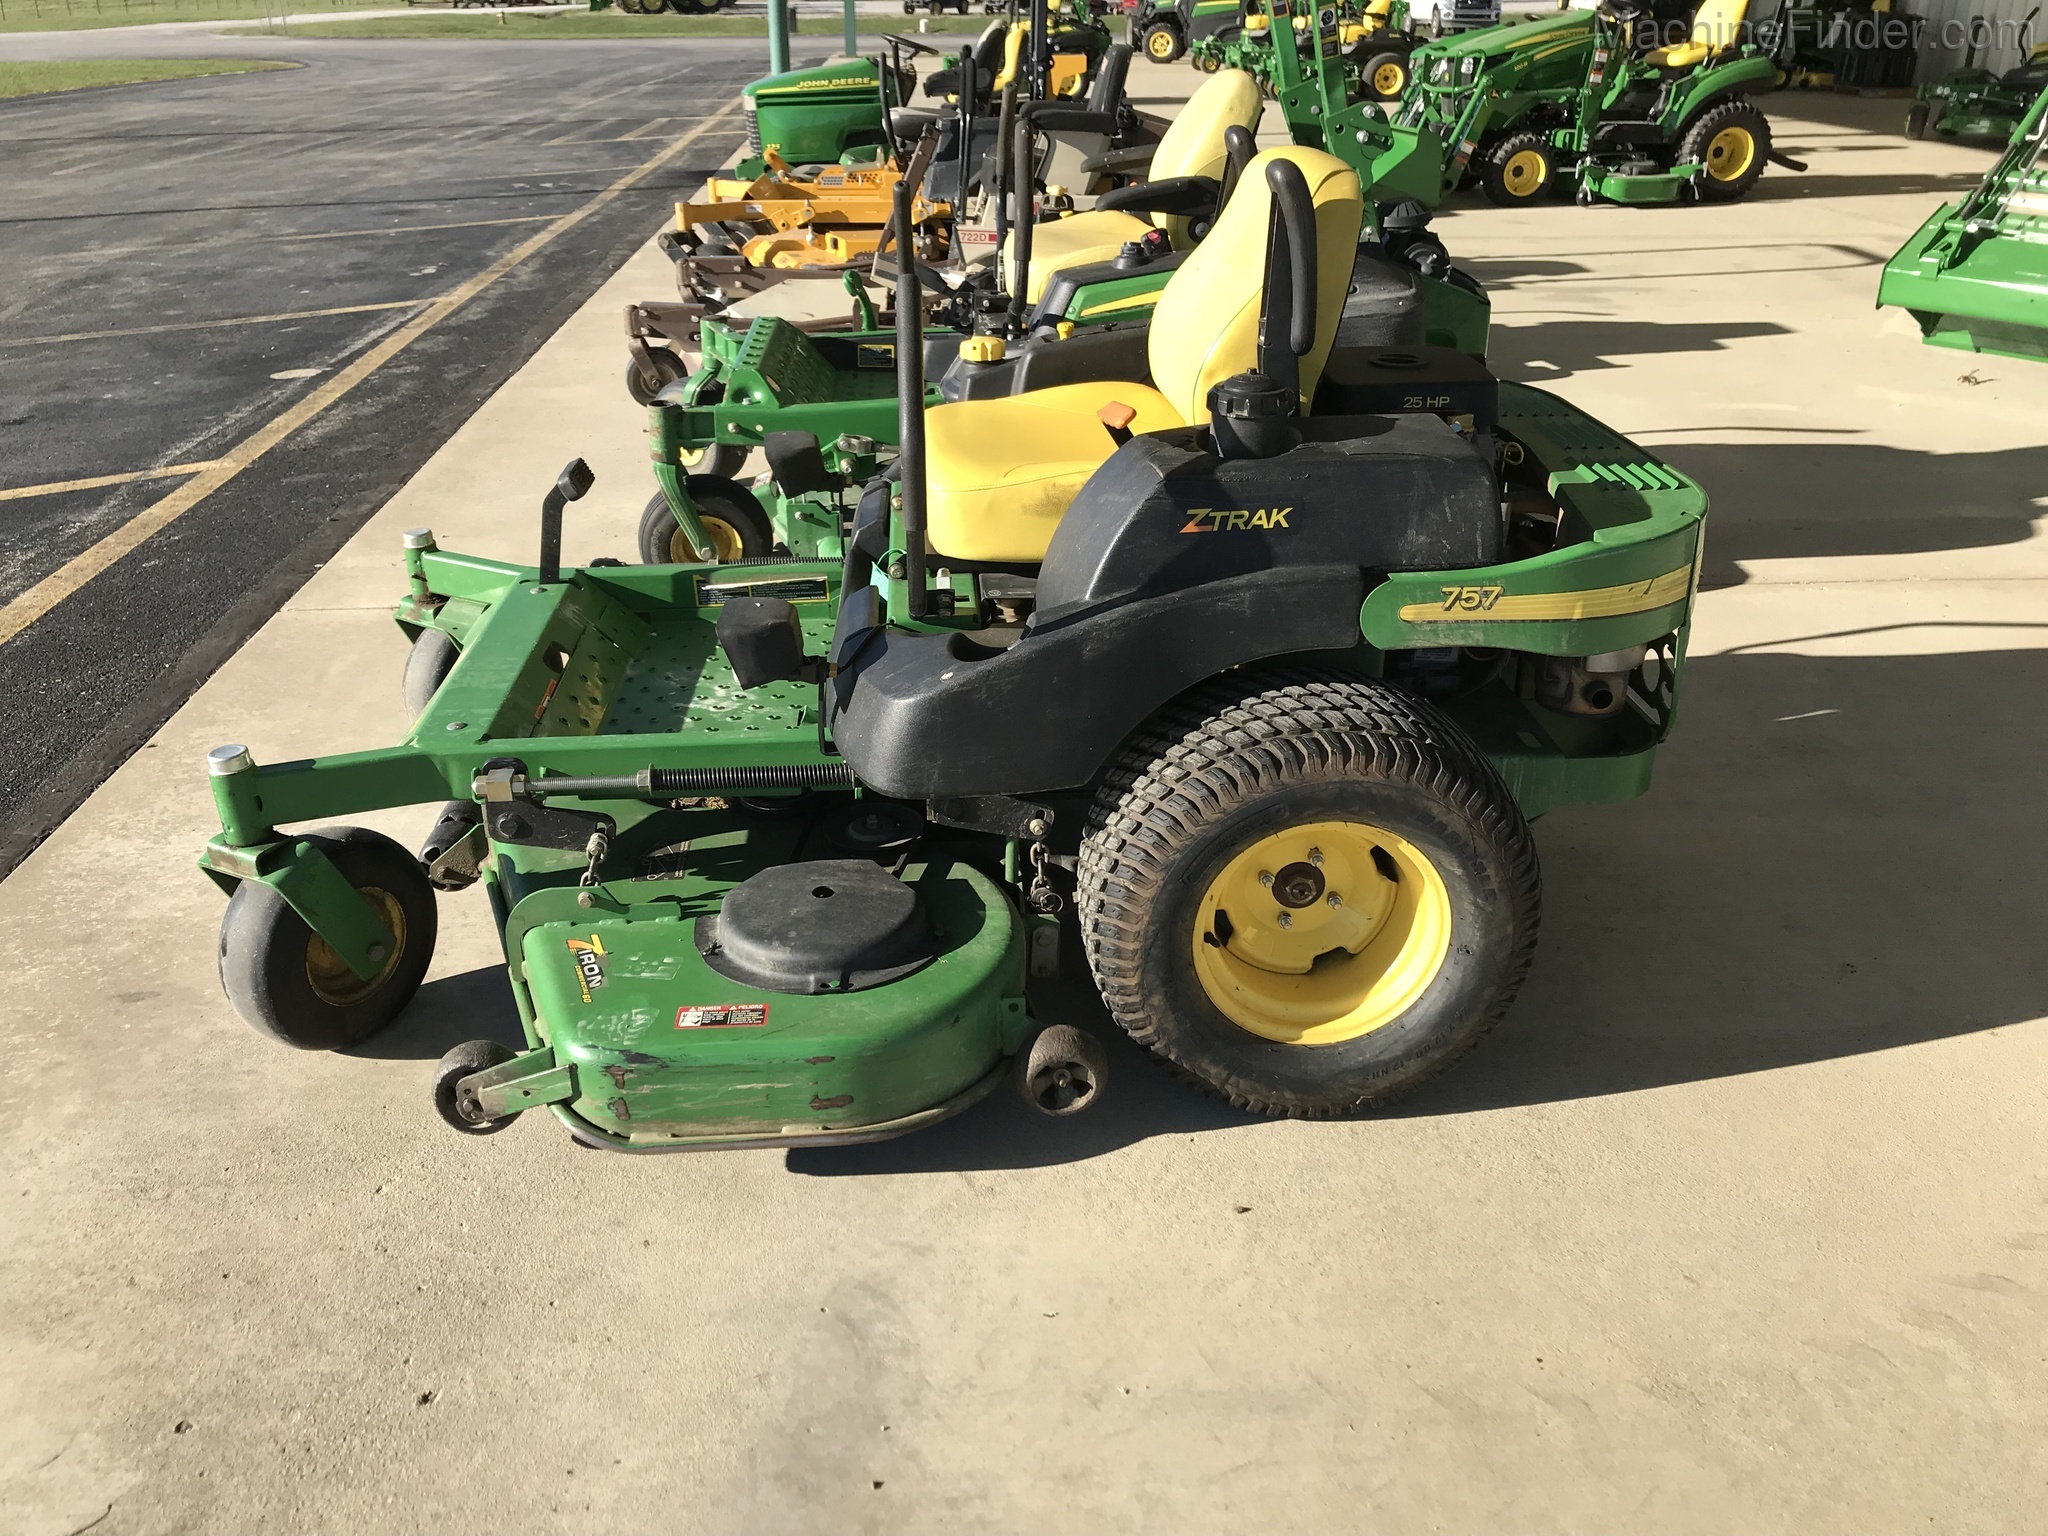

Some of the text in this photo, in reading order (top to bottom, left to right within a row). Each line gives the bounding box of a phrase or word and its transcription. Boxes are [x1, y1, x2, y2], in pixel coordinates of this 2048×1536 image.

[797, 77, 871, 89] JOHN DEERE
[961, 232, 987, 242] 722D
[1403, 396, 1451, 408] 25 HP
[1441, 585, 1504, 611] 757
[577, 949, 603, 989] IRON
